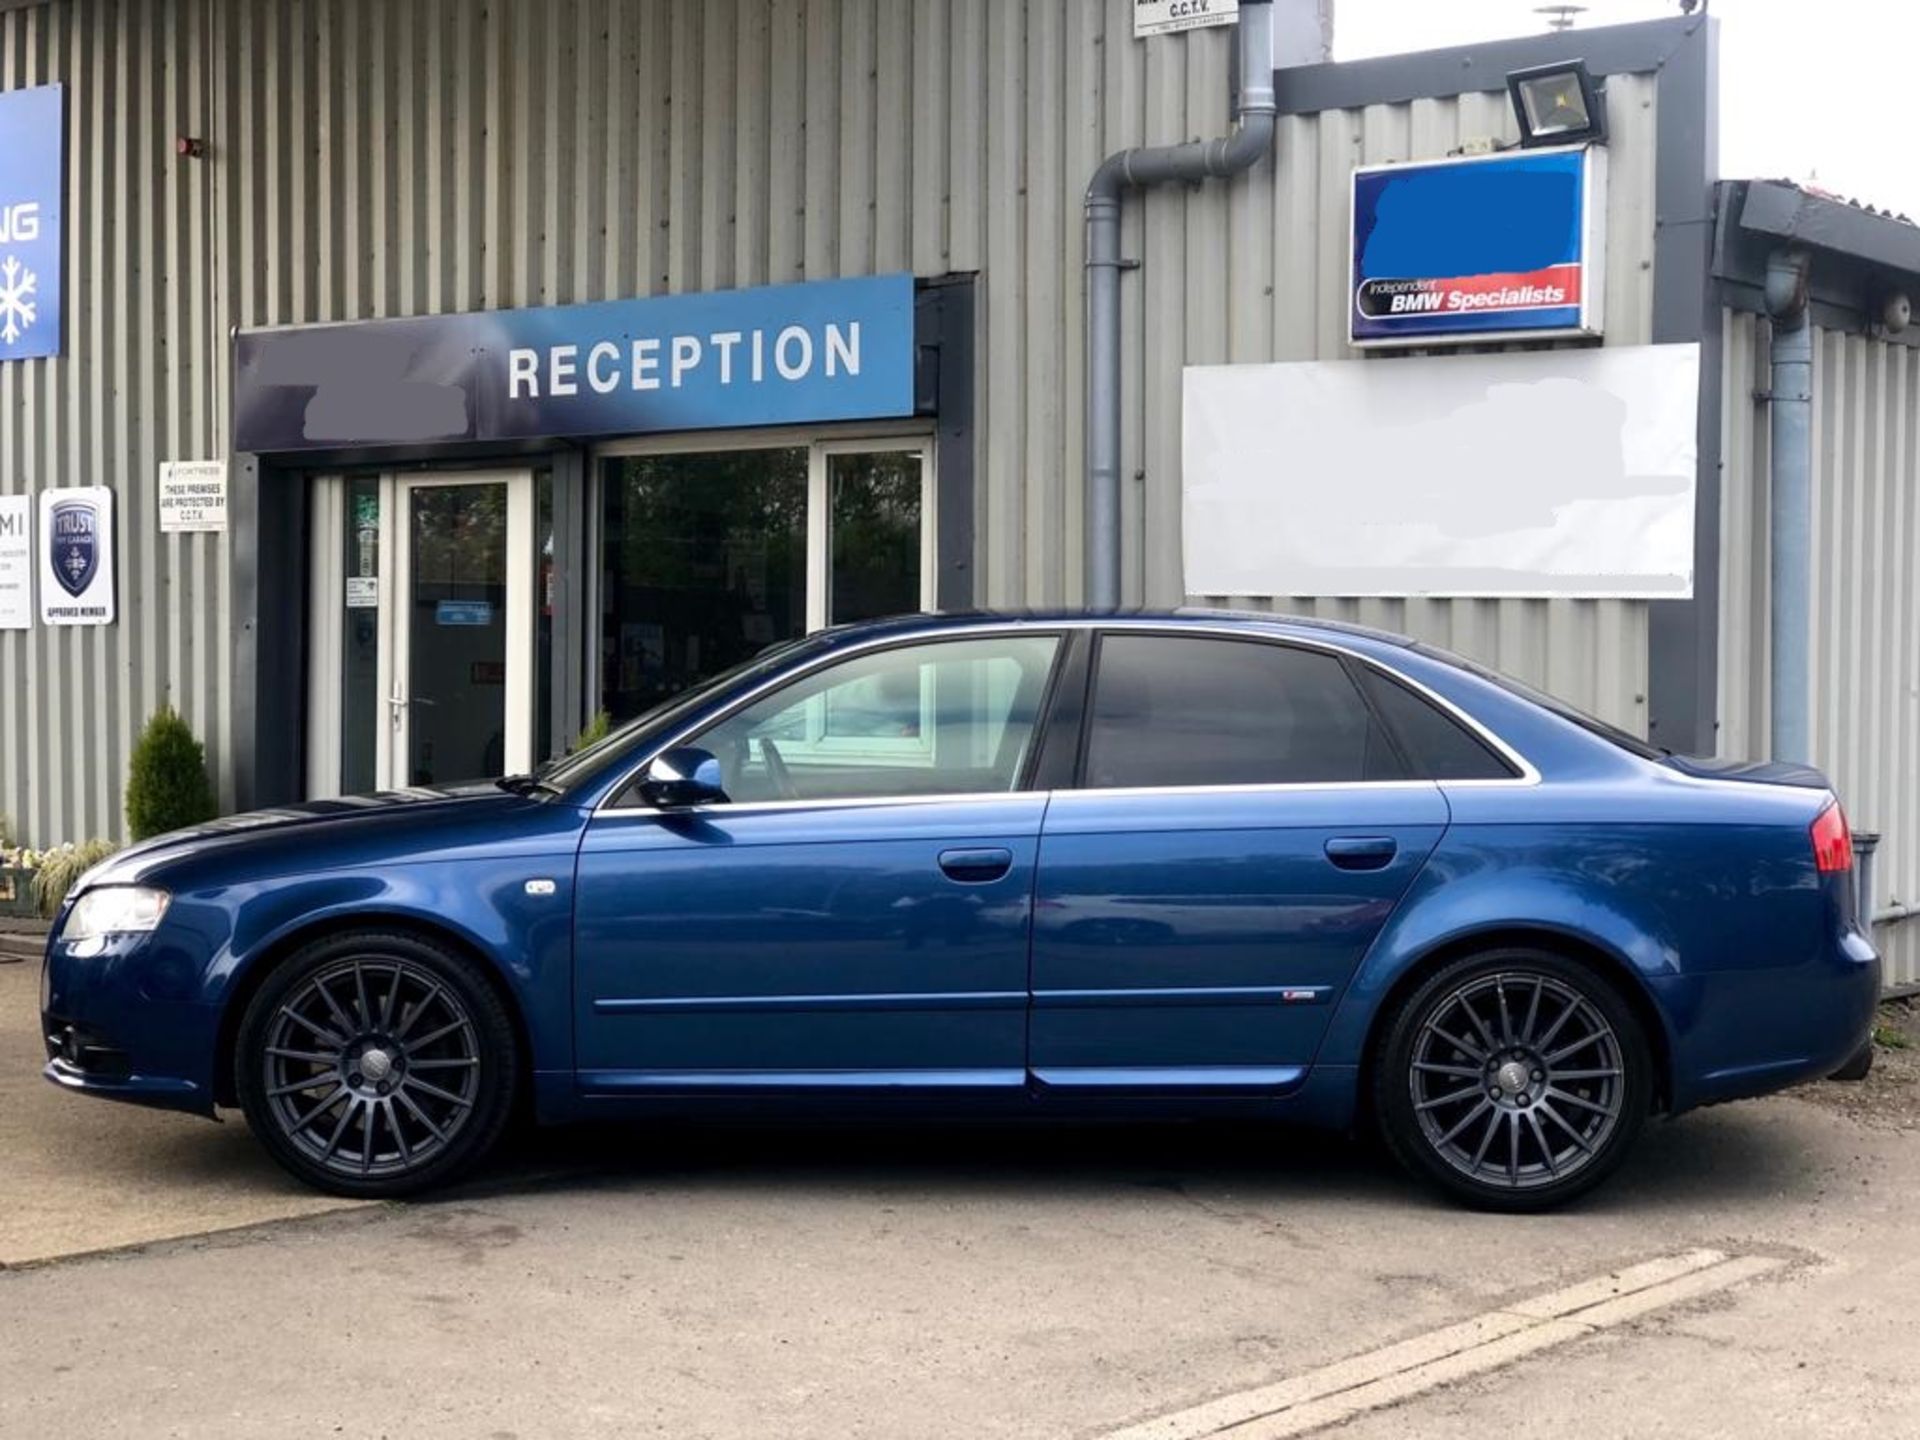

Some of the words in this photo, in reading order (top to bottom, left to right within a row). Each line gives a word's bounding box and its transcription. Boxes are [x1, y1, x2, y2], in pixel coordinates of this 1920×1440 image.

[1390, 292, 1443, 312] BMW
[1447, 285, 1565, 313] Specialists
[509, 322, 860, 398] RECEPTION
[165, 485, 185, 495] THESE
[187, 483, 220, 494] PREMISES
[162, 498, 173, 508] ARE
[175, 497, 214, 507] PROTECTED
[216, 496, 224, 507] BY
[57, 513, 92, 534] TRUST
[47, 607, 79, 617] APPROVED
[80, 606, 106, 617] MEMBER
